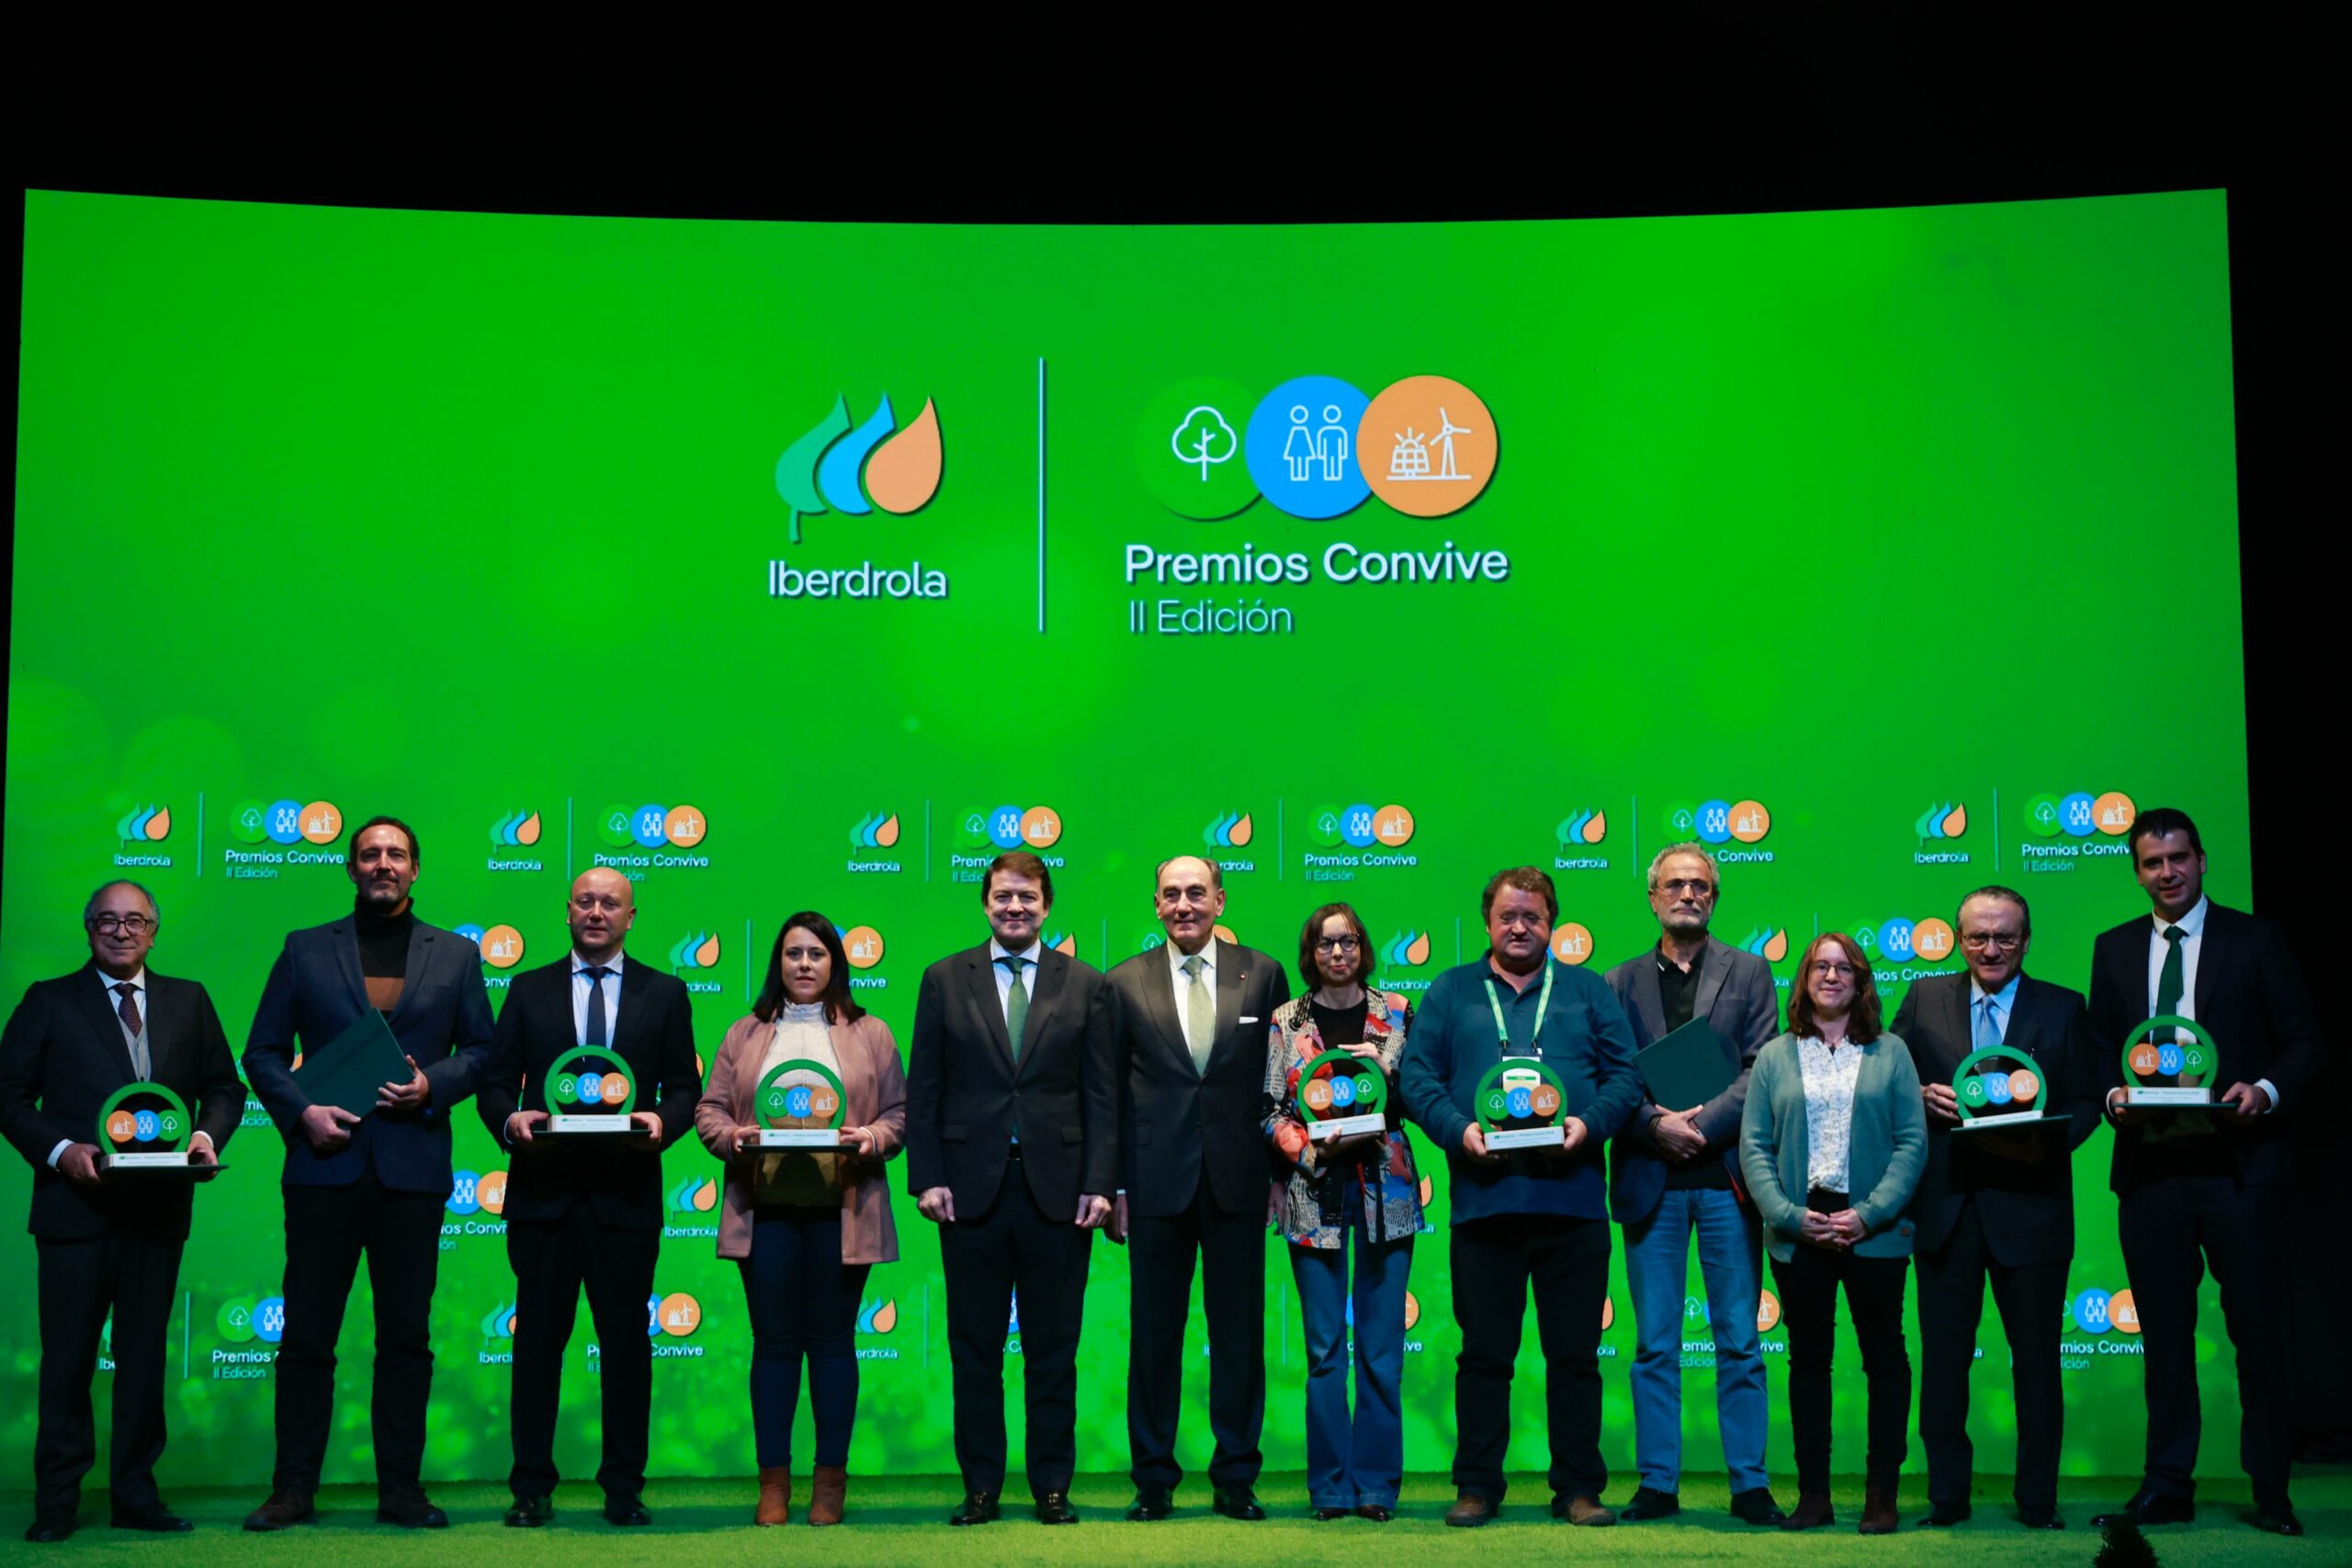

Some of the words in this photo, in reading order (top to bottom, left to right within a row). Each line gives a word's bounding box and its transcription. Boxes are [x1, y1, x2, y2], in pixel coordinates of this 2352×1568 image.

[1125, 541, 1310, 582] Premios
[1322, 540, 1509, 582] Convive
[768, 559, 948, 597] Iberdrola
[1129, 599, 1144, 633] II
[1158, 597, 1293, 633] Edición
[2021, 842, 2079, 856] Premios
[2082, 840, 2130, 855] Conviv
[113, 853, 172, 866] Iberdrola
[225, 850, 283, 863] Premios
[287, 850, 345, 864] Convive
[594, 853, 650, 867] Premios
[653, 853, 709, 867] Convive
[952, 854, 994, 868] Premi
[1305, 853, 1360, 867] Premios
[1362, 853, 1418, 867] Convive
[1555, 857, 1608, 869] Iberdrola
[1718, 850, 1774, 863] Convive
[1914, 851, 1970, 863] Iberdrola
[487, 859, 542, 871] Iberdrola
[847, 860, 900, 873] Iberdrola
[1219, 861, 1254, 872] rdrola
[2031, 860, 2075, 873] Edición
[235, 866, 278, 879] Edición
[960, 871, 985, 883] Edic
[1313, 870, 1355, 882] Edición
[848, 976, 887, 987] nvive
[465, 1221, 508, 1235] Convi
[1682, 1338, 1715, 1352] emio
[2060, 1340, 2095, 1354] mios
[212, 1349, 271, 1363] Premios
[479, 1351, 513, 1364] Iberd
[855, 1348, 898, 1359] erdrola
[222, 1366, 266, 1380] Edición
